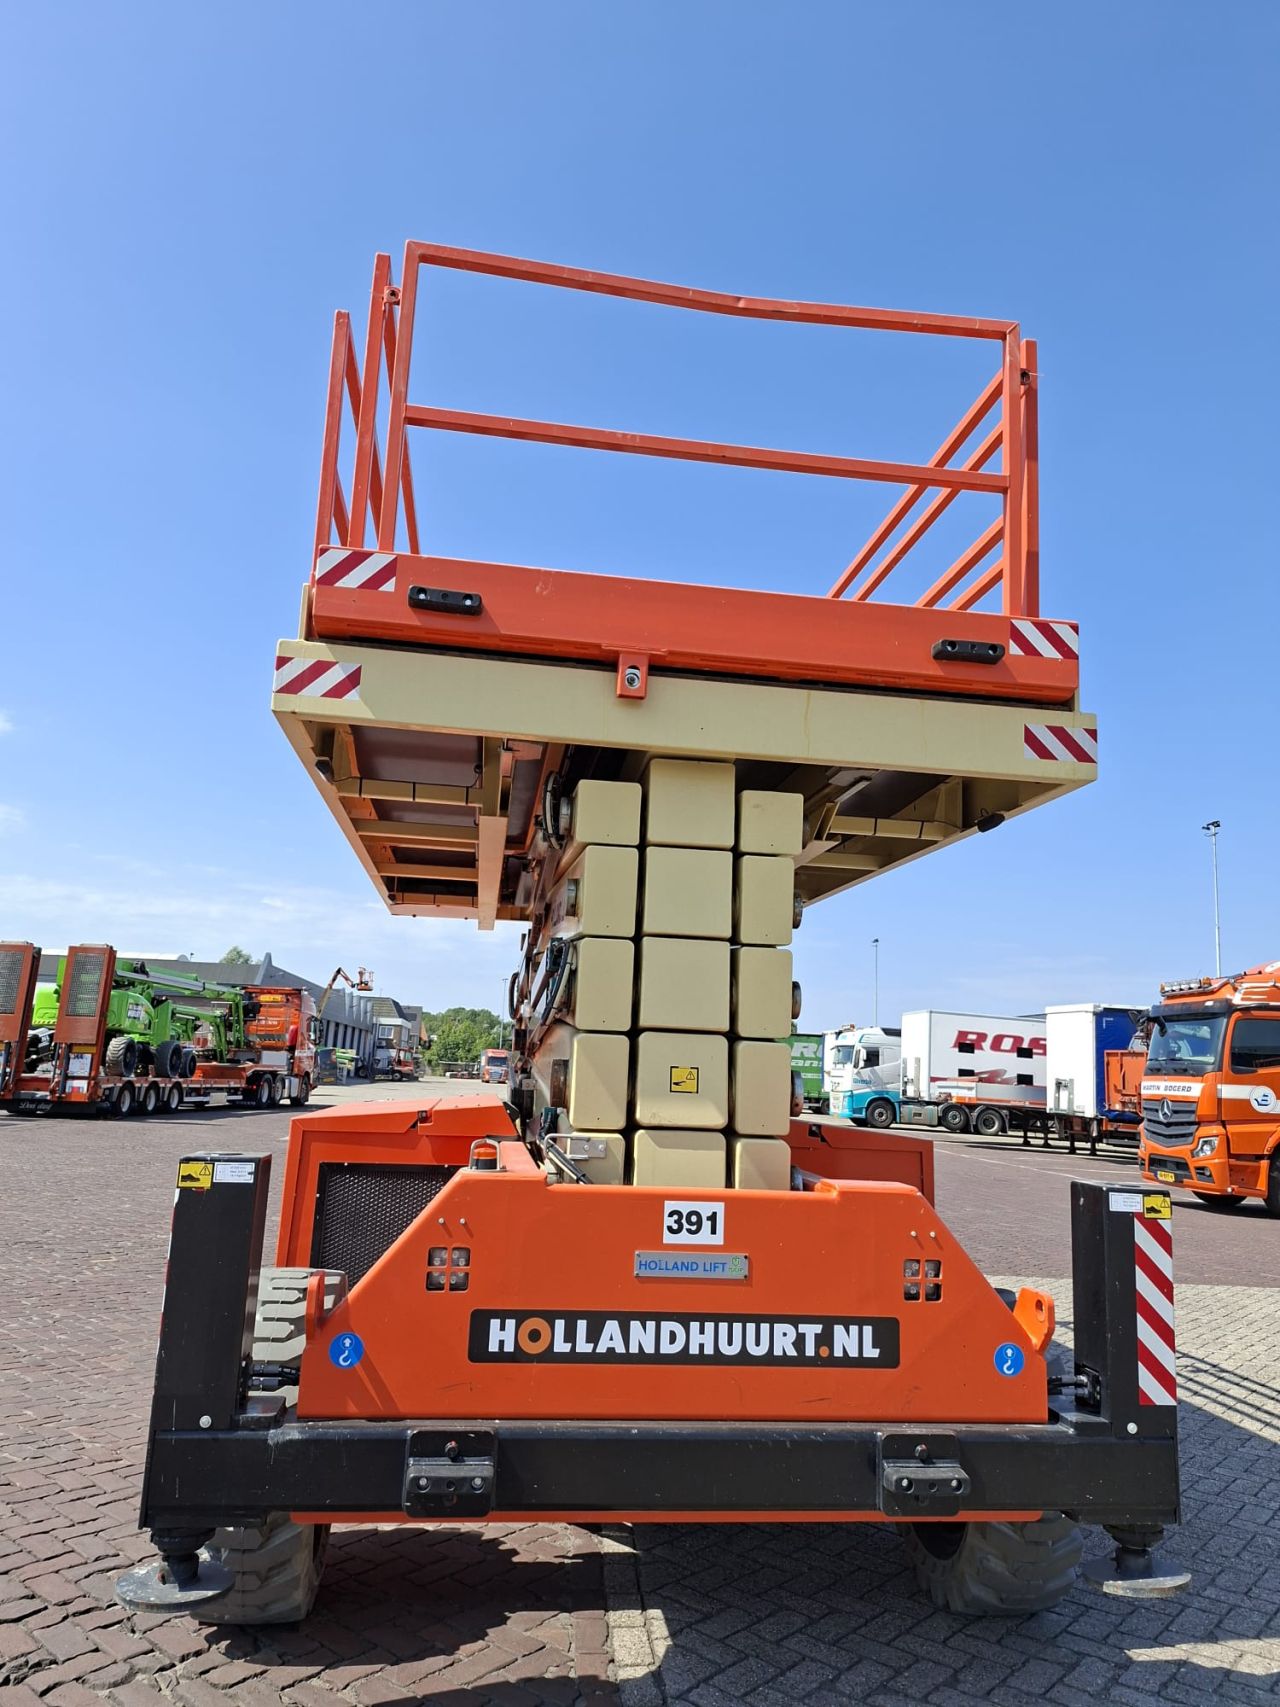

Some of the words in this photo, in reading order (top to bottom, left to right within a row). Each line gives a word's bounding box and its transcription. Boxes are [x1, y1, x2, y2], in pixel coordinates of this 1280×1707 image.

[666, 1209, 718, 1235] 391
[638, 1260, 699, 1272] HOLLAND
[702, 1262, 727, 1273] LIFT
[488, 1317, 881, 1359] HOLLANDHUURT.NL
